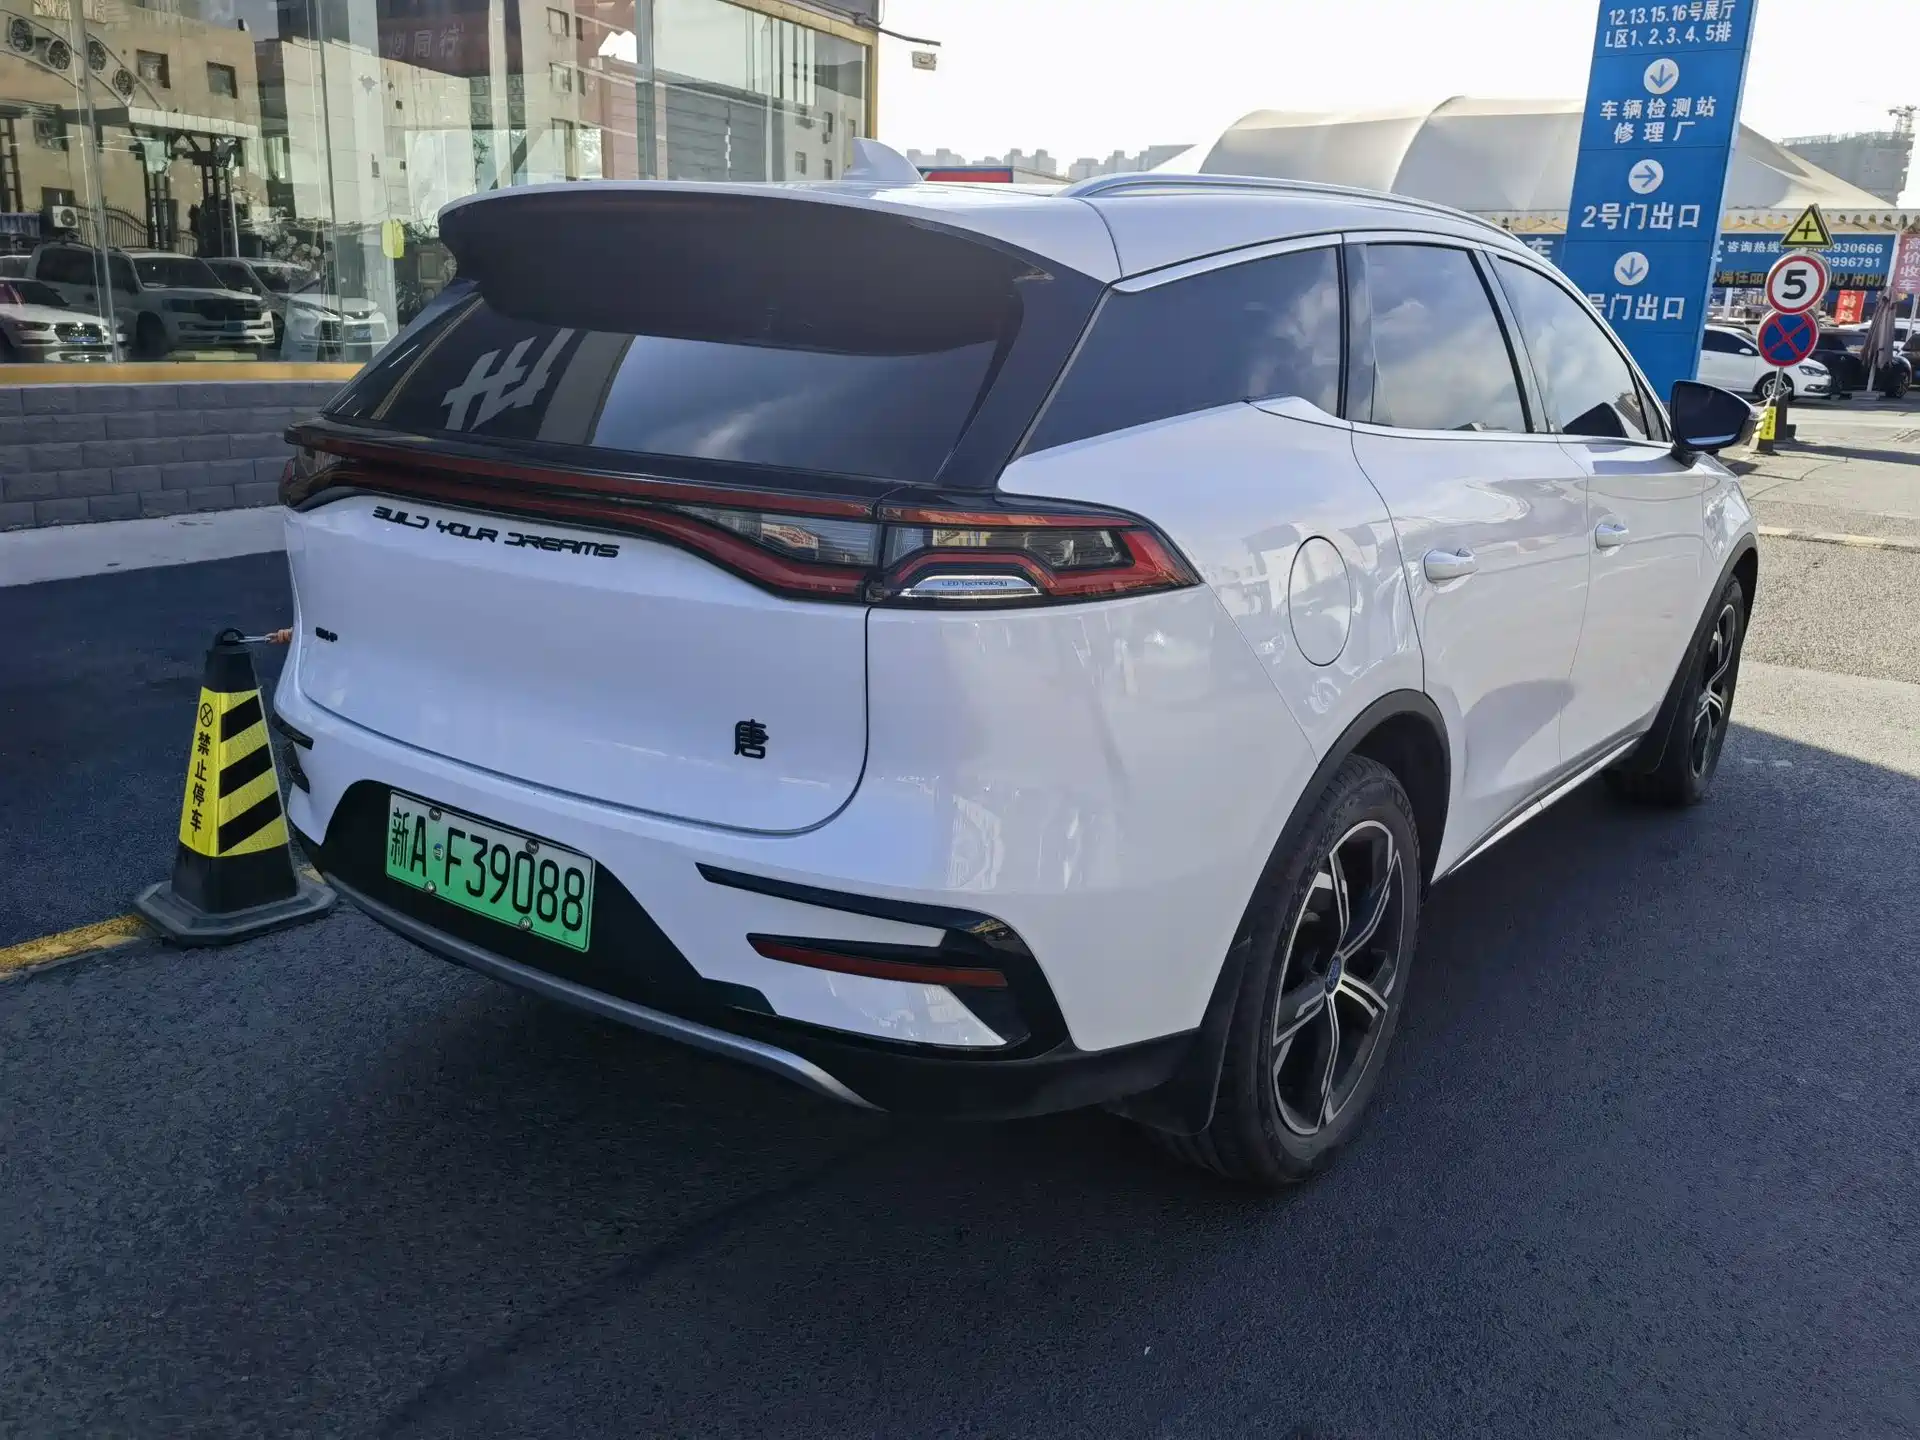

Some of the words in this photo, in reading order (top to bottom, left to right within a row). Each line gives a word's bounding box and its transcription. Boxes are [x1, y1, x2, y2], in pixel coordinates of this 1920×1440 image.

[1600, 96, 1716, 120] 车辆检测站
[1613, 121, 1696, 144] 修理厂
[1580, 201, 1700, 230] 2号门出口
[1782, 269, 1807, 300] 5
[372, 505, 430, 530] BUILD
[435, 519, 499, 543] YOUR
[504, 532, 620, 558] DREAMS
[734, 718, 769, 760] 唐
[190, 731, 211, 832] 禁止停车
